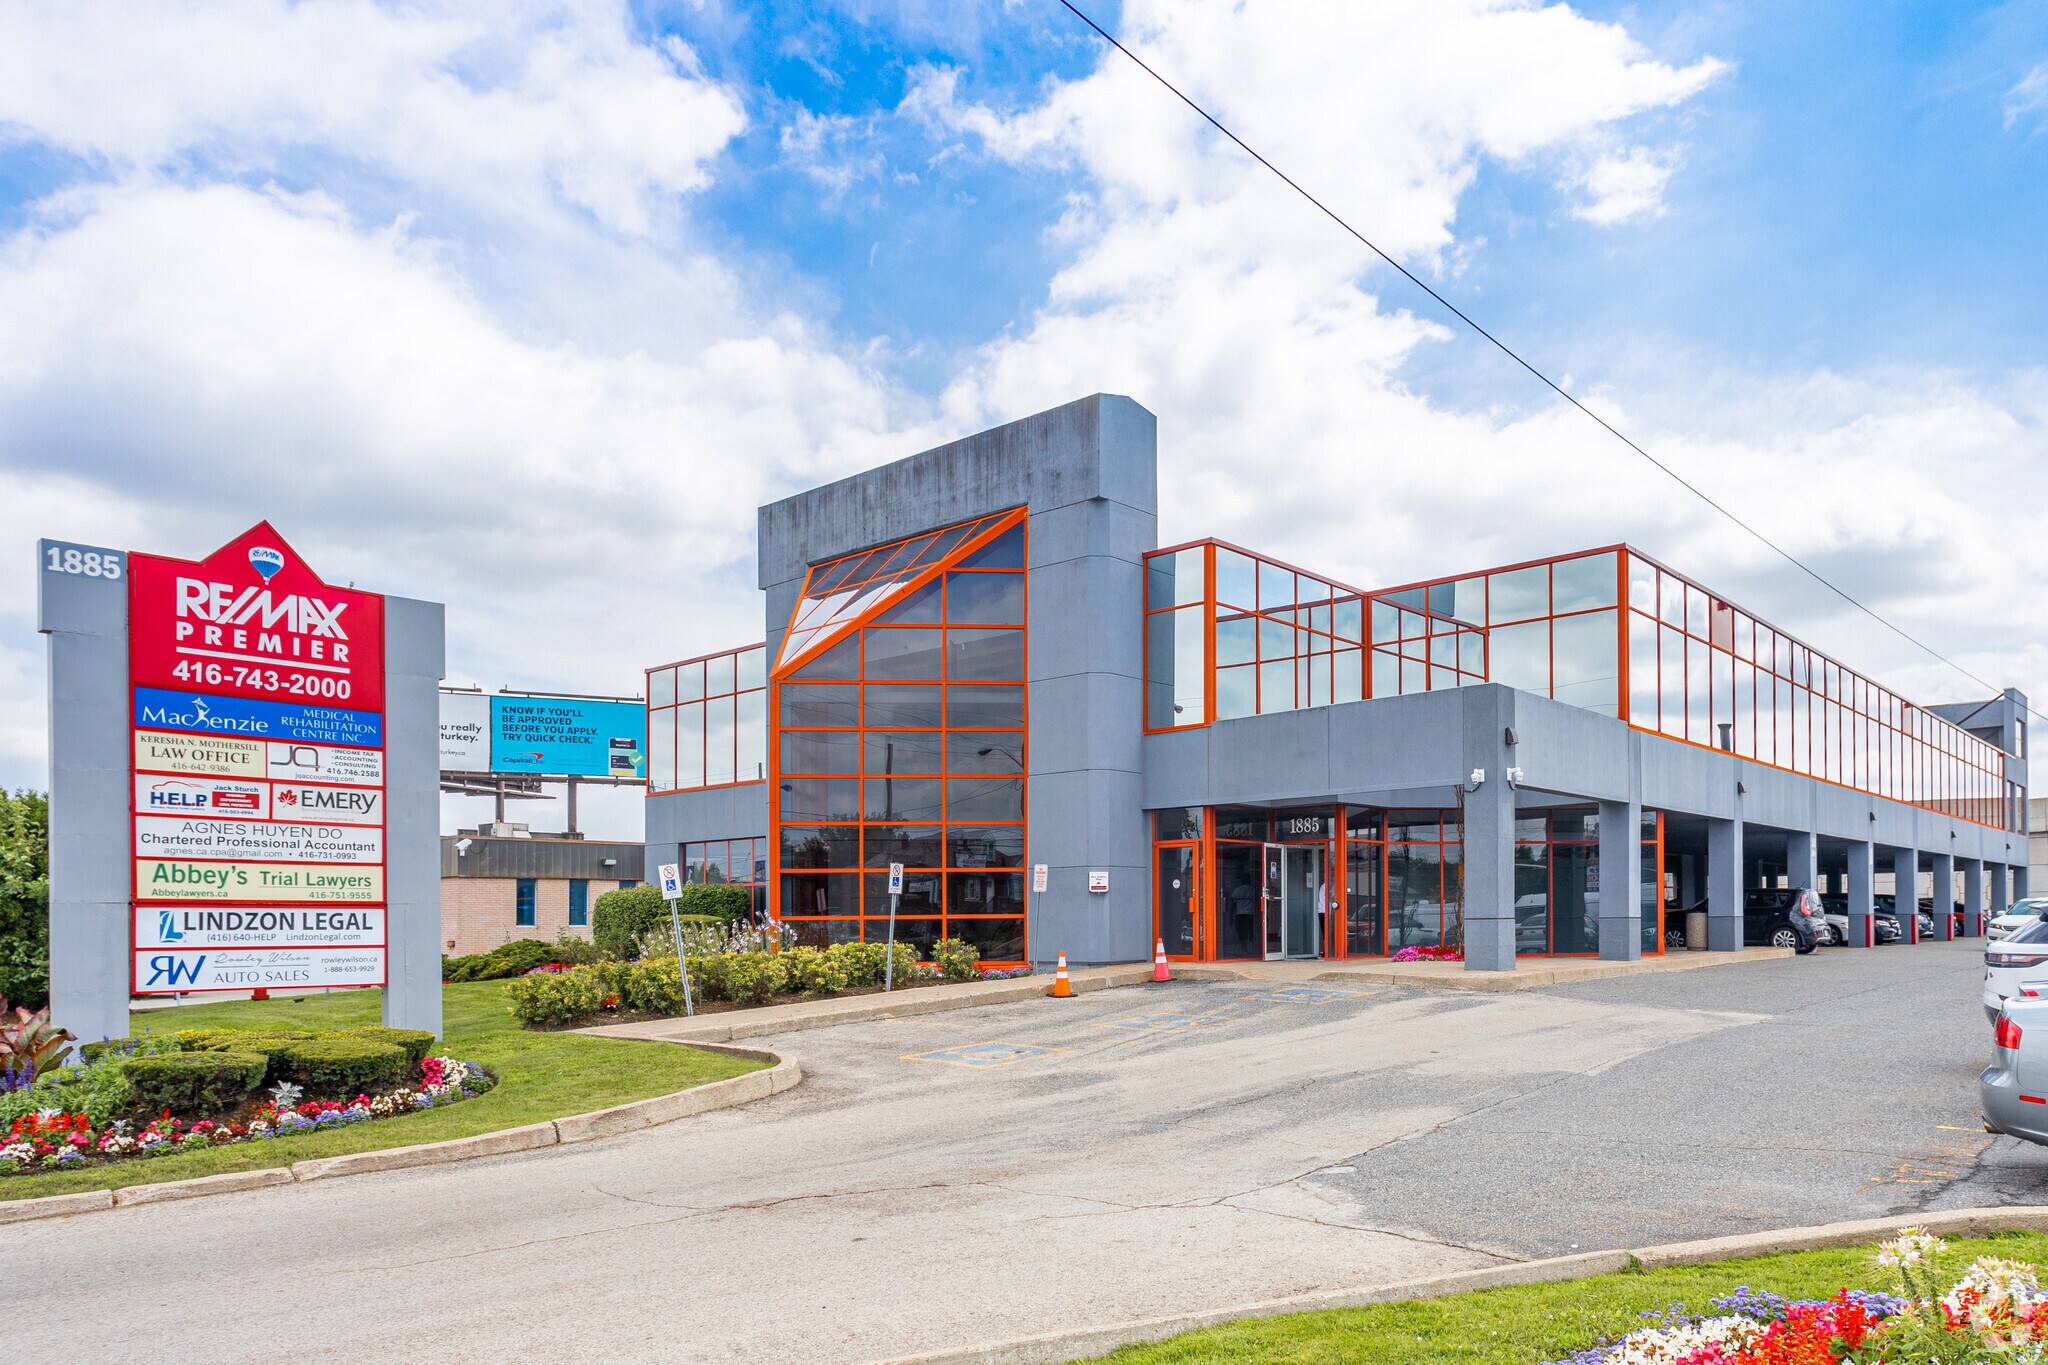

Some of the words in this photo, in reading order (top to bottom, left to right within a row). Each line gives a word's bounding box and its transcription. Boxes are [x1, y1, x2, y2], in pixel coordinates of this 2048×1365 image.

[252, 549, 281, 561] RE/MAX
[46, 546, 121, 581] 1885
[176, 577, 349, 641] RE/MAX
[176, 621, 350, 663] PREMIER
[172, 660, 351, 700] 416-743-2000
[303, 708, 356, 723] MEDICAL
[502, 706, 534, 715] KNOW
[537, 707, 546, 715] IF
[548, 708, 583, 717] YOU'LL
[281, 716, 377, 734] REHABILITATION
[502, 715, 515, 723] BE
[517, 716, 572, 726] APPROVED
[451, 723, 482, 734] really
[502, 724, 541, 733] BEFORE
[543, 725, 564, 734] YOU
[567, 727, 599, 736] APPLY.
[292, 728, 338, 741] CENTRE
[342, 732, 366, 744] INC.
[440, 733, 479, 743] turkey.
[502, 733, 522, 741] TRY
[525, 733, 556, 743] QUICK
[140, 735, 184, 747] KERESHA
[187, 739, 197, 747] N.
[200, 740, 260, 752] MOTHERSILL
[150, 746, 187, 759] LAW
[191, 749, 250, 764] OFFICE
[334, 748, 360, 757] INCOME
[334, 755, 379, 764] ACCOUNTING
[334, 761, 377, 769] CONSULTING
[171, 762, 231, 773] 416-642-9386
[326, 767, 380, 778] 416.746.2588
[295, 772, 355, 783] jqaccounting.com
[213, 784, 232, 792] Jack
[181, 821, 247, 835] AGNES
[252, 825, 312, 838] HUYEN
[318, 827, 343, 840] DO
[1289, 816, 1320, 834] 1885
[141, 833, 212, 846] Chartered
[217, 836, 300, 849] Professional
[304, 840, 376, 852] Accountant
[163, 847, 283, 858] agnes.ca.cpa@gmail.com
[298, 851, 357, 860] 416-731-0993
[152, 863, 248, 889] Abbey's
[259, 871, 298, 886] Trial
[306, 872, 372, 890] Lawyers
[151, 888, 229, 898] Abbeylawyers.ca
[308, 891, 372, 899] 416-751-9555
[184, 912, 295, 931] LINDZON
[303, 912, 373, 931] LEGAL
[207, 933, 232, 943] (416)
[233, 933, 277, 941] 640-HELP
[286, 933, 361, 943] LindzonLegal.com
[214, 952, 263, 966] Rowley
[268, 951, 310, 963] Wilson
[321, 956, 378, 965] rowleywilson.ca
[324, 965, 375, 973] 1-888-653-9929
[213, 971, 260, 984] AUTO
[265, 970, 310, 982] SALES
